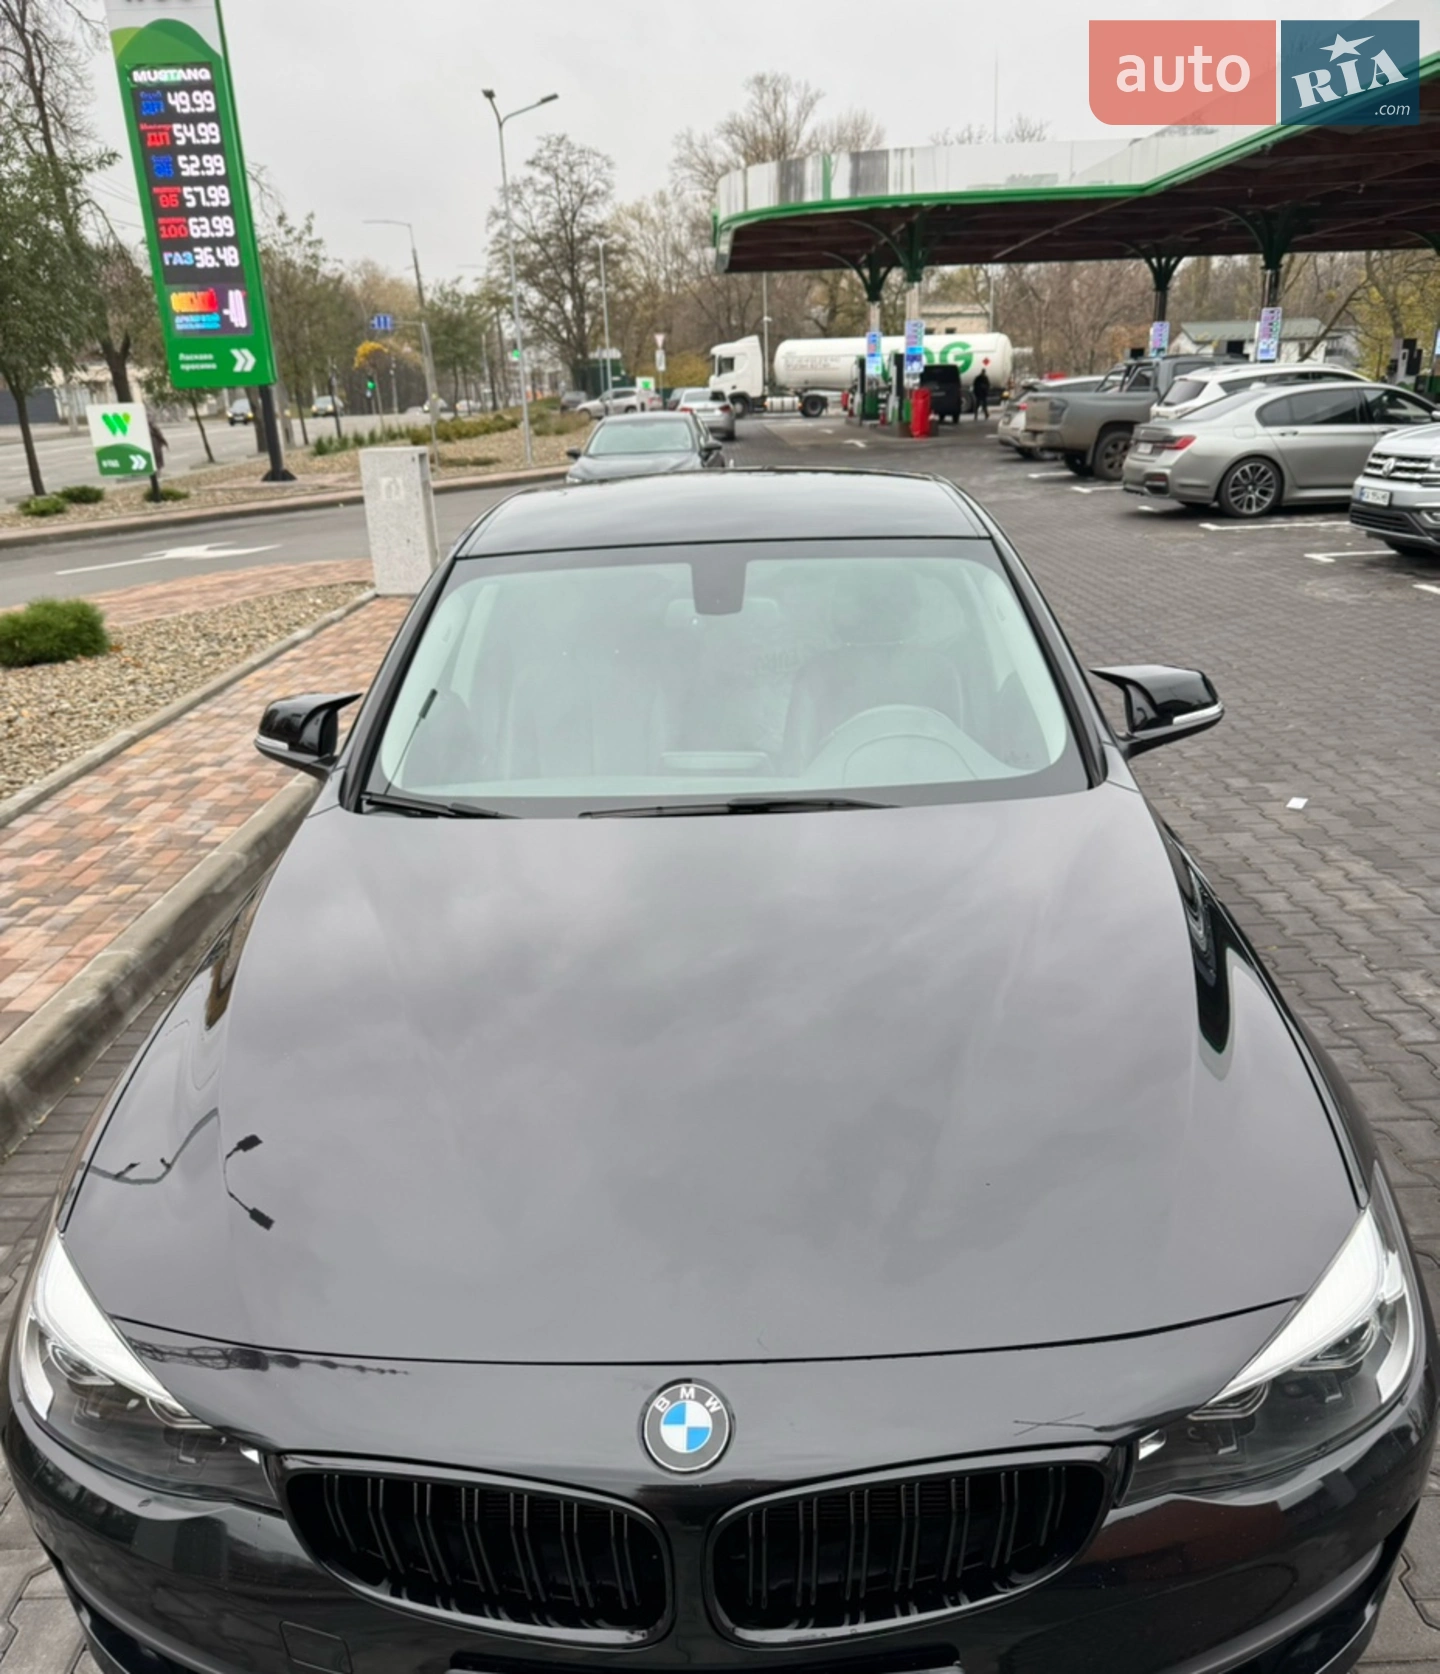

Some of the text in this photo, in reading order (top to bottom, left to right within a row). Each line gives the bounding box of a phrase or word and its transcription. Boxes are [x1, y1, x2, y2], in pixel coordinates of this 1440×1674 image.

[132, 68, 211, 82] MUSTANG
[167, 90, 216, 113] 49.99
[172, 122, 221, 146] 54.99
[177, 154, 226, 176] 52.99
[183, 185, 231, 208] 57.99
[160, 216, 236, 239] 100 63.99
[163, 246, 240, 268] ГАЗ 36.48
[653, 1386, 723, 1414] BMW
